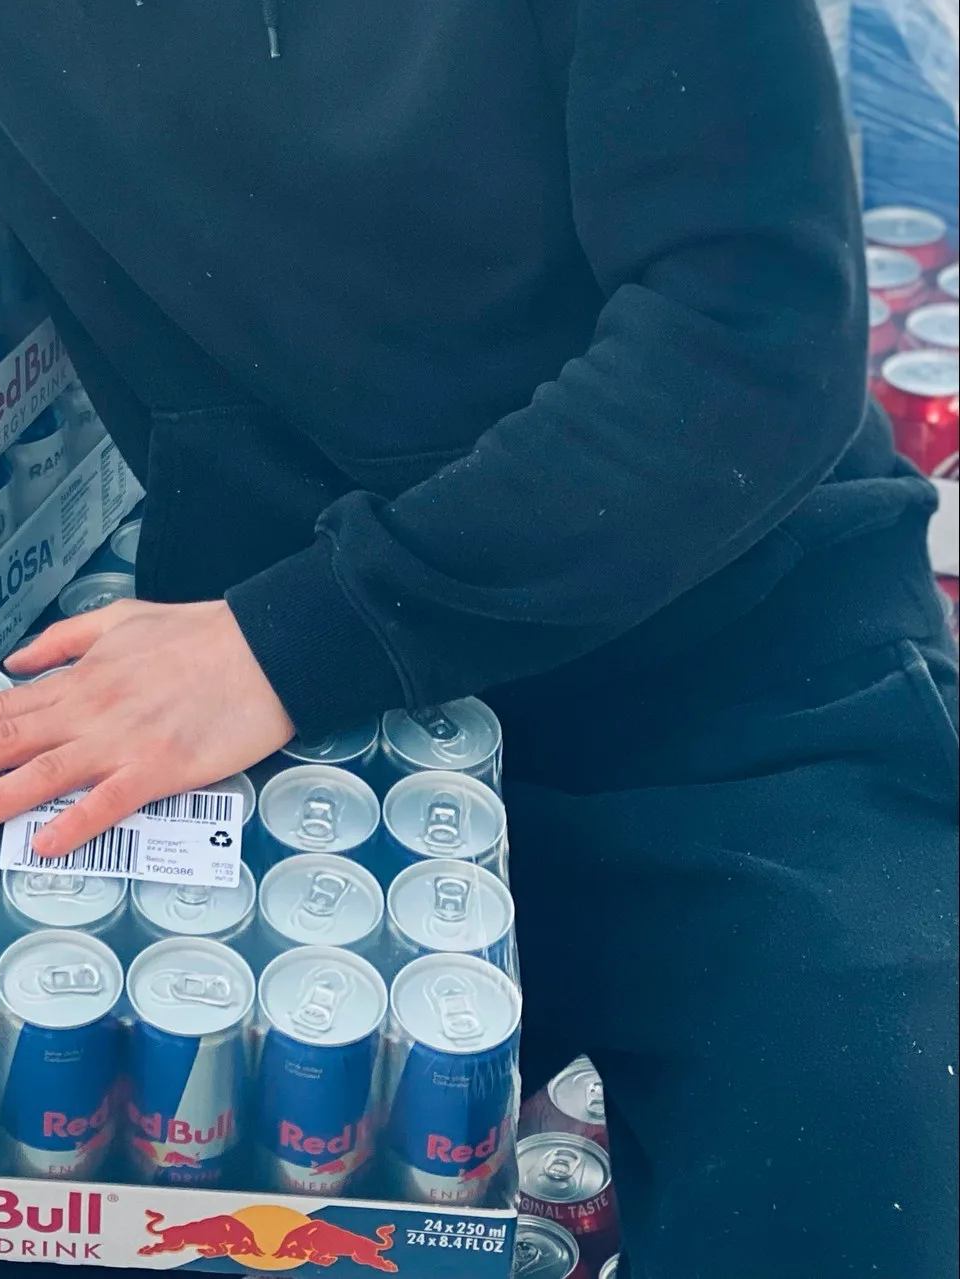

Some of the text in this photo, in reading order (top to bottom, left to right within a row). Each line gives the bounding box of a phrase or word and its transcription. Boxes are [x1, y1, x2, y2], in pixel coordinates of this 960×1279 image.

[146, 864, 194, 876] 1900386
[168, 1108, 233, 1145] Bull
[279, 1120, 351, 1155] Red
[427, 1125, 496, 1163] Red
[520, 1193, 609, 1220] GINAL TASTE
[424, 1219, 507, 1238] 24 x 250 ml
[407, 1232, 505, 1253] 24 x 8.4 FL OZ
